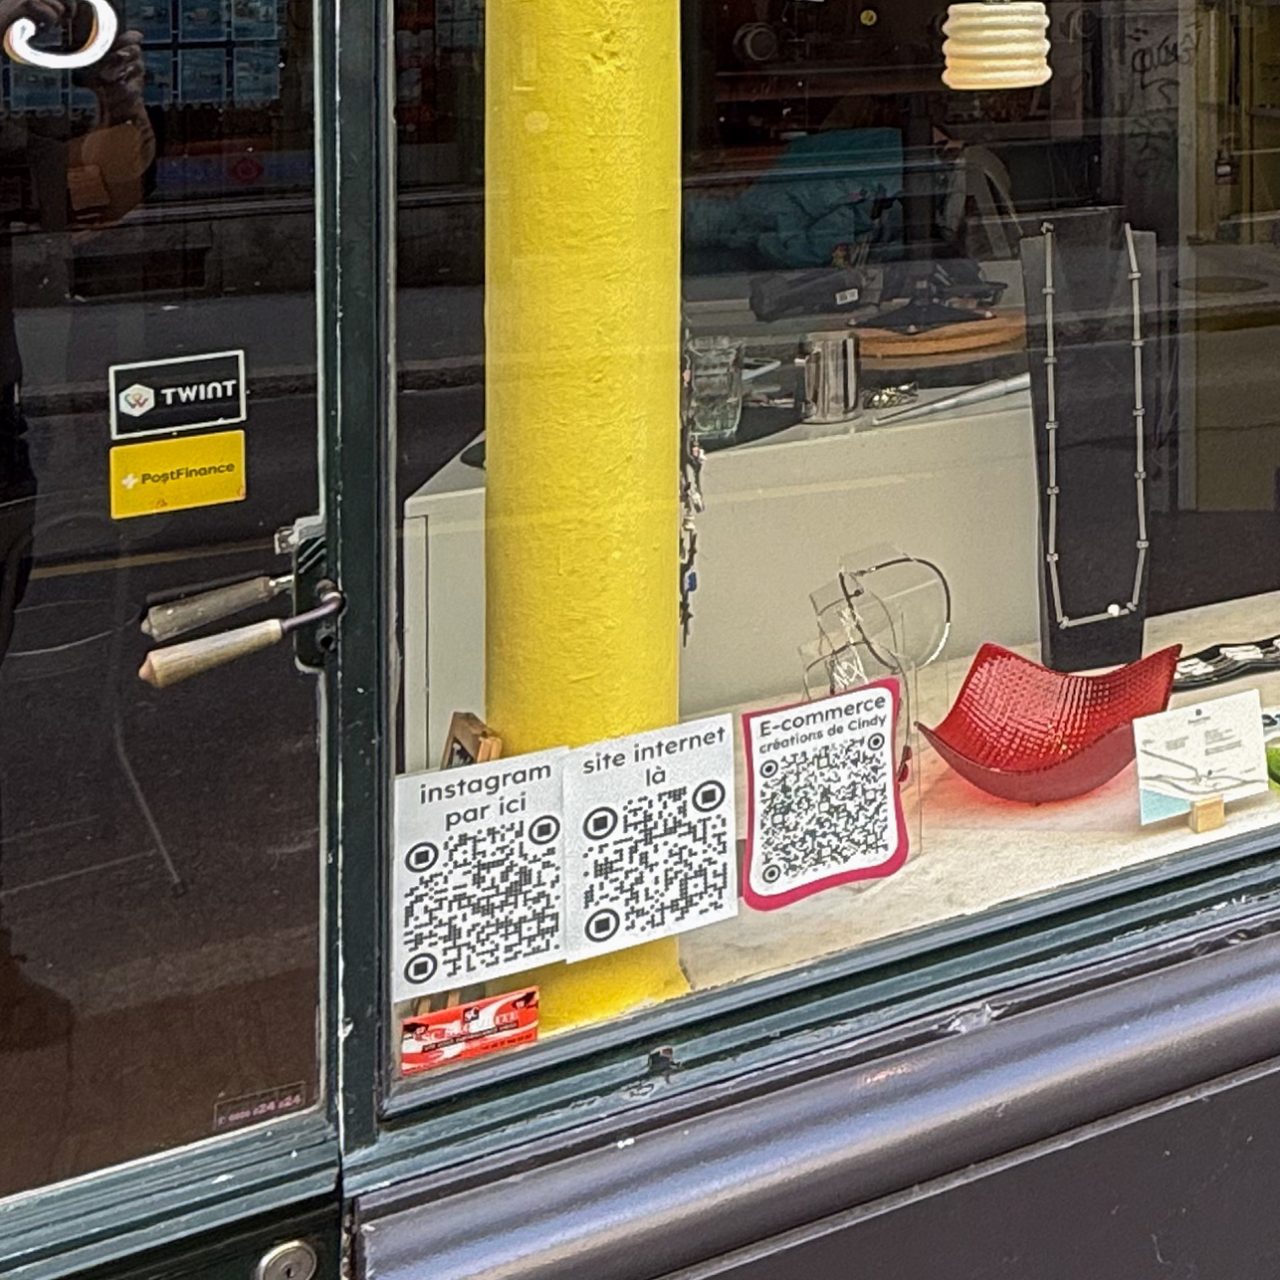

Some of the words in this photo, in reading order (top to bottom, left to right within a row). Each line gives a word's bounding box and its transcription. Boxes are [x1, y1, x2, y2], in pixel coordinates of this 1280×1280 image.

[161, 380, 237, 405] TWINT
[141, 463, 236, 485] PostFinance
[759, 694, 887, 738] E-commerce
[759, 730, 824, 755] créations
[826, 724, 845, 742] de
[846, 713, 888, 735] Cindy
[582, 748, 626, 776] site
[633, 726, 727, 765] internet
[419, 762, 553, 806] instagram
[645, 766, 667, 787] là
[444, 803, 491, 832] par
[498, 791, 527, 817] ici
